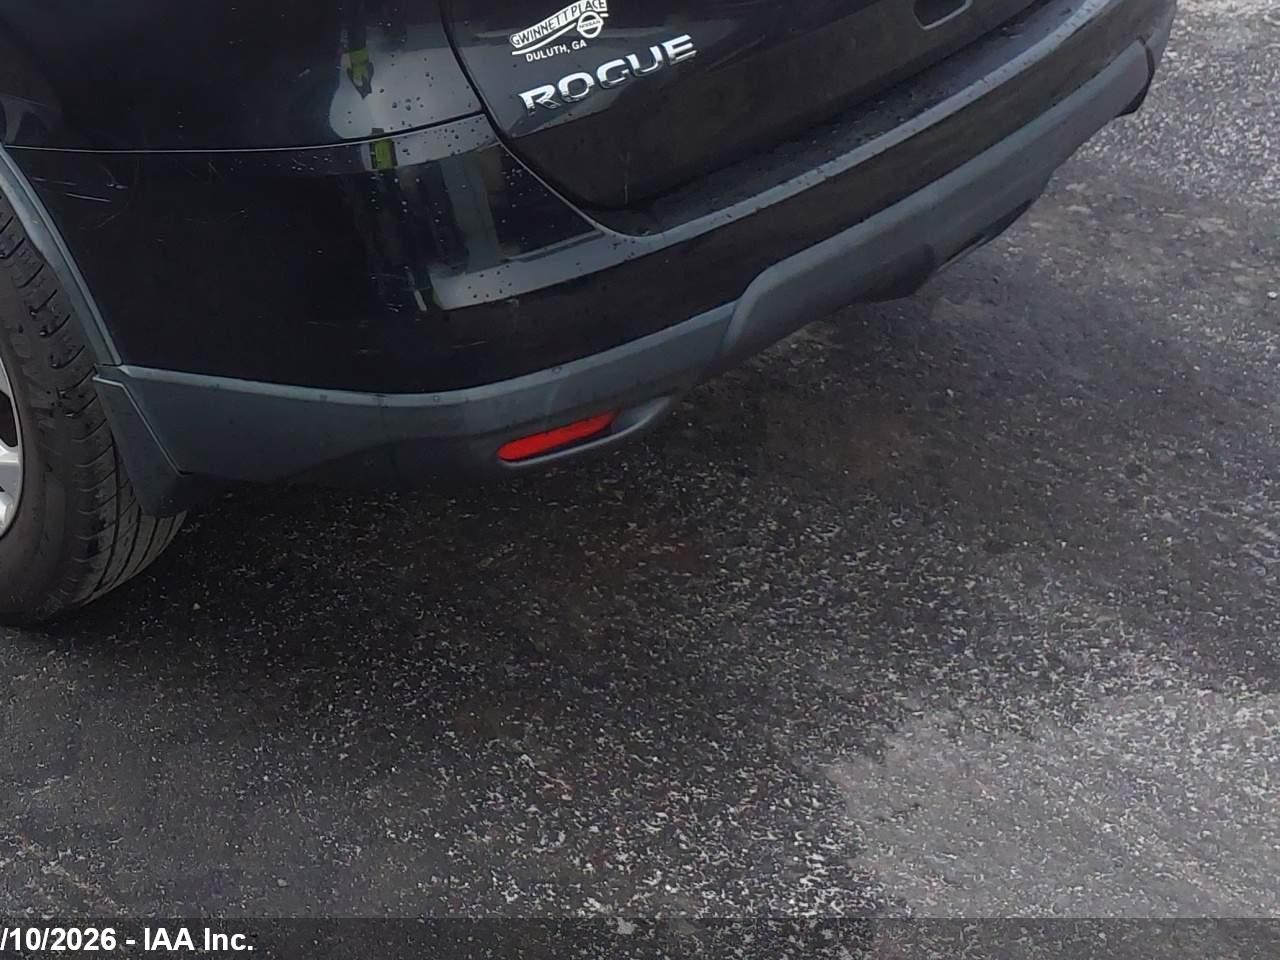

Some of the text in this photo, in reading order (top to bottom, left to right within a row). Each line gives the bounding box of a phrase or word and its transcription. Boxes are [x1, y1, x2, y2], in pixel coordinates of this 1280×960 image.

[510, 10, 570, 46] GWINNETT
[525, 39, 588, 63] DULUTH, GA
[518, 34, 697, 116] ROGUE
